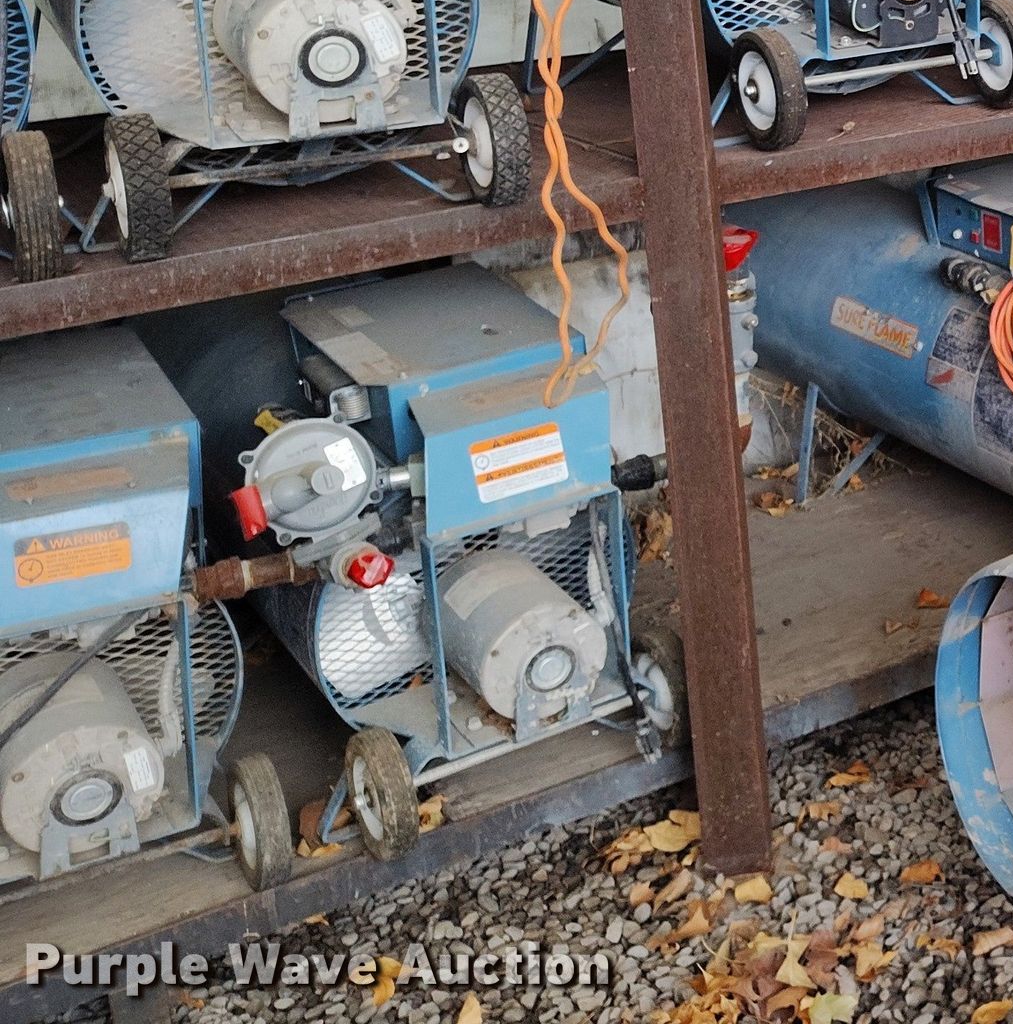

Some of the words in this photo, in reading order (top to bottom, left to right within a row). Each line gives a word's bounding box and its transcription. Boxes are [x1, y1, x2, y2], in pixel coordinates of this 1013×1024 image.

[838, 303, 865, 329] SURE
[868, 320, 913, 349] FLAME
[49, 529, 119, 550] WARNING
